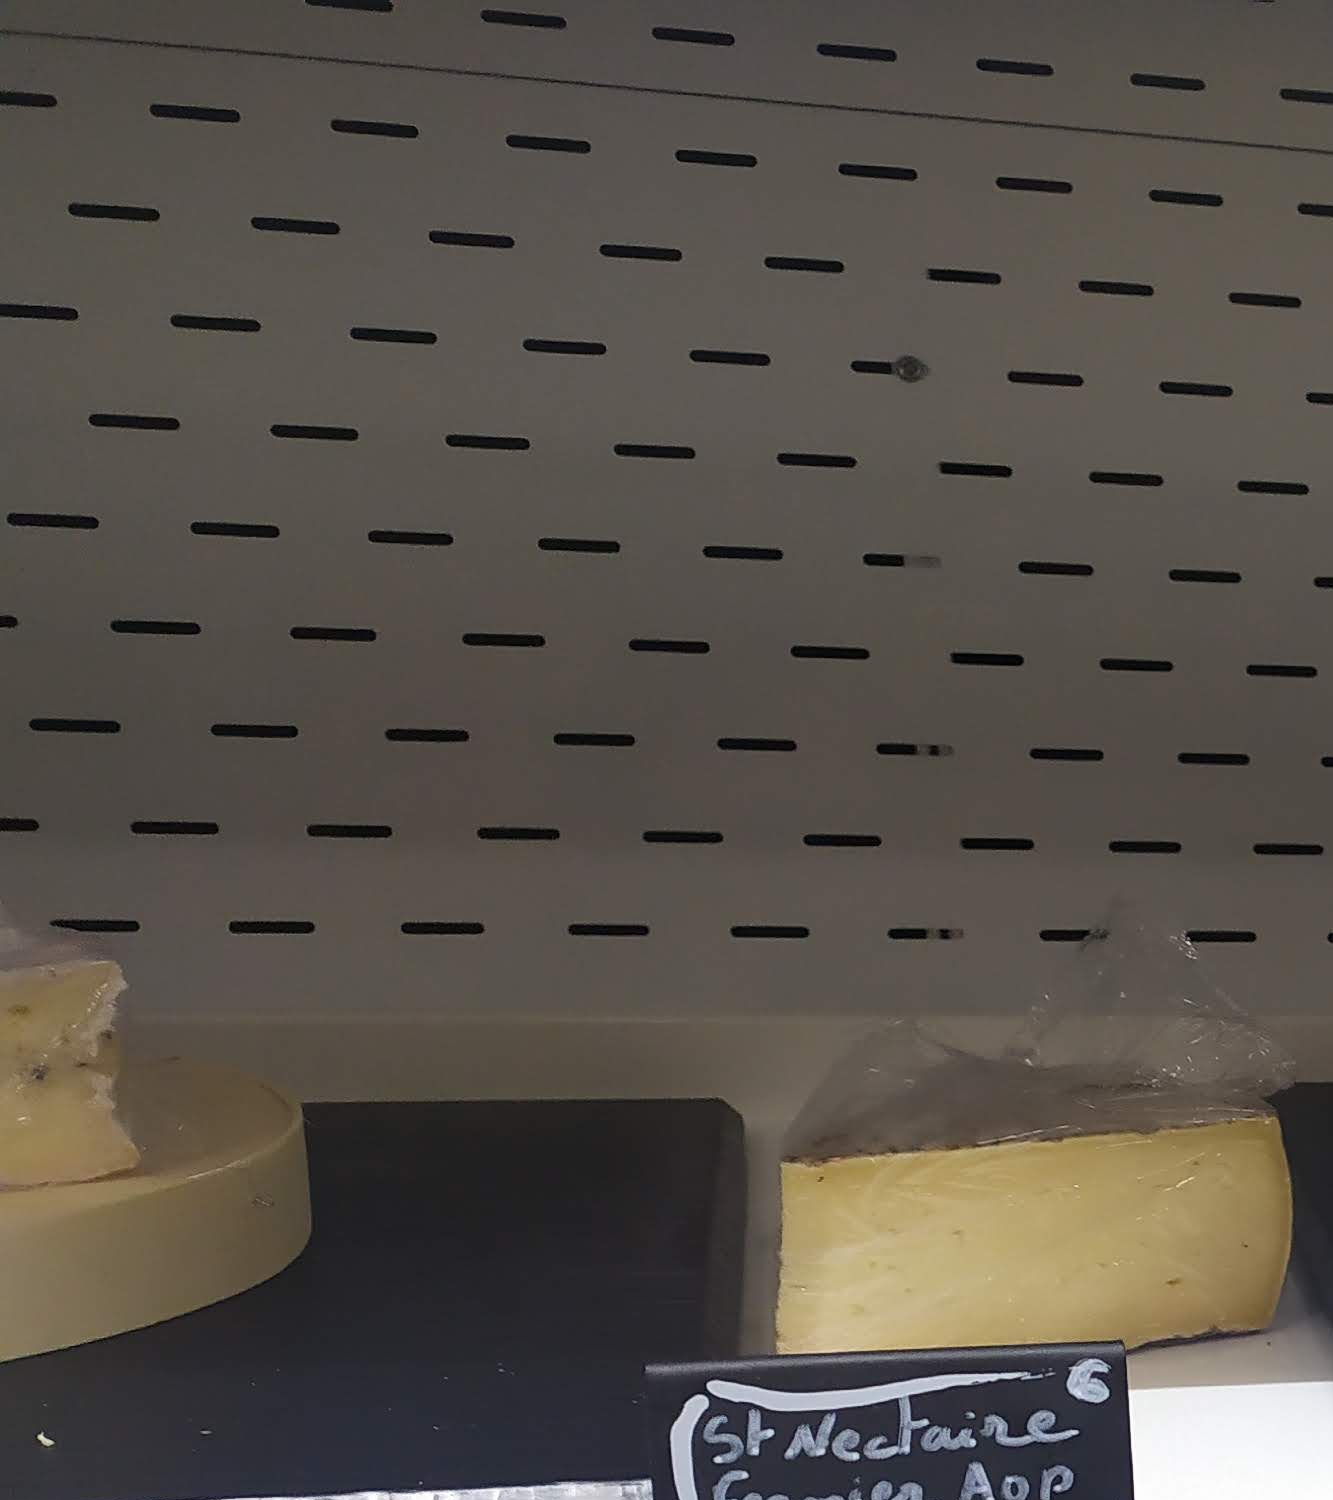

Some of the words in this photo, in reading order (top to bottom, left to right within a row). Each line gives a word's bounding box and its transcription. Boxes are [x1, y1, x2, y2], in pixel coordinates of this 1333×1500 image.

[1066, 1357, 1111, 1403] 6
[702, 1409, 775, 1464] St
[784, 1395, 1081, 1462] Nectaire
